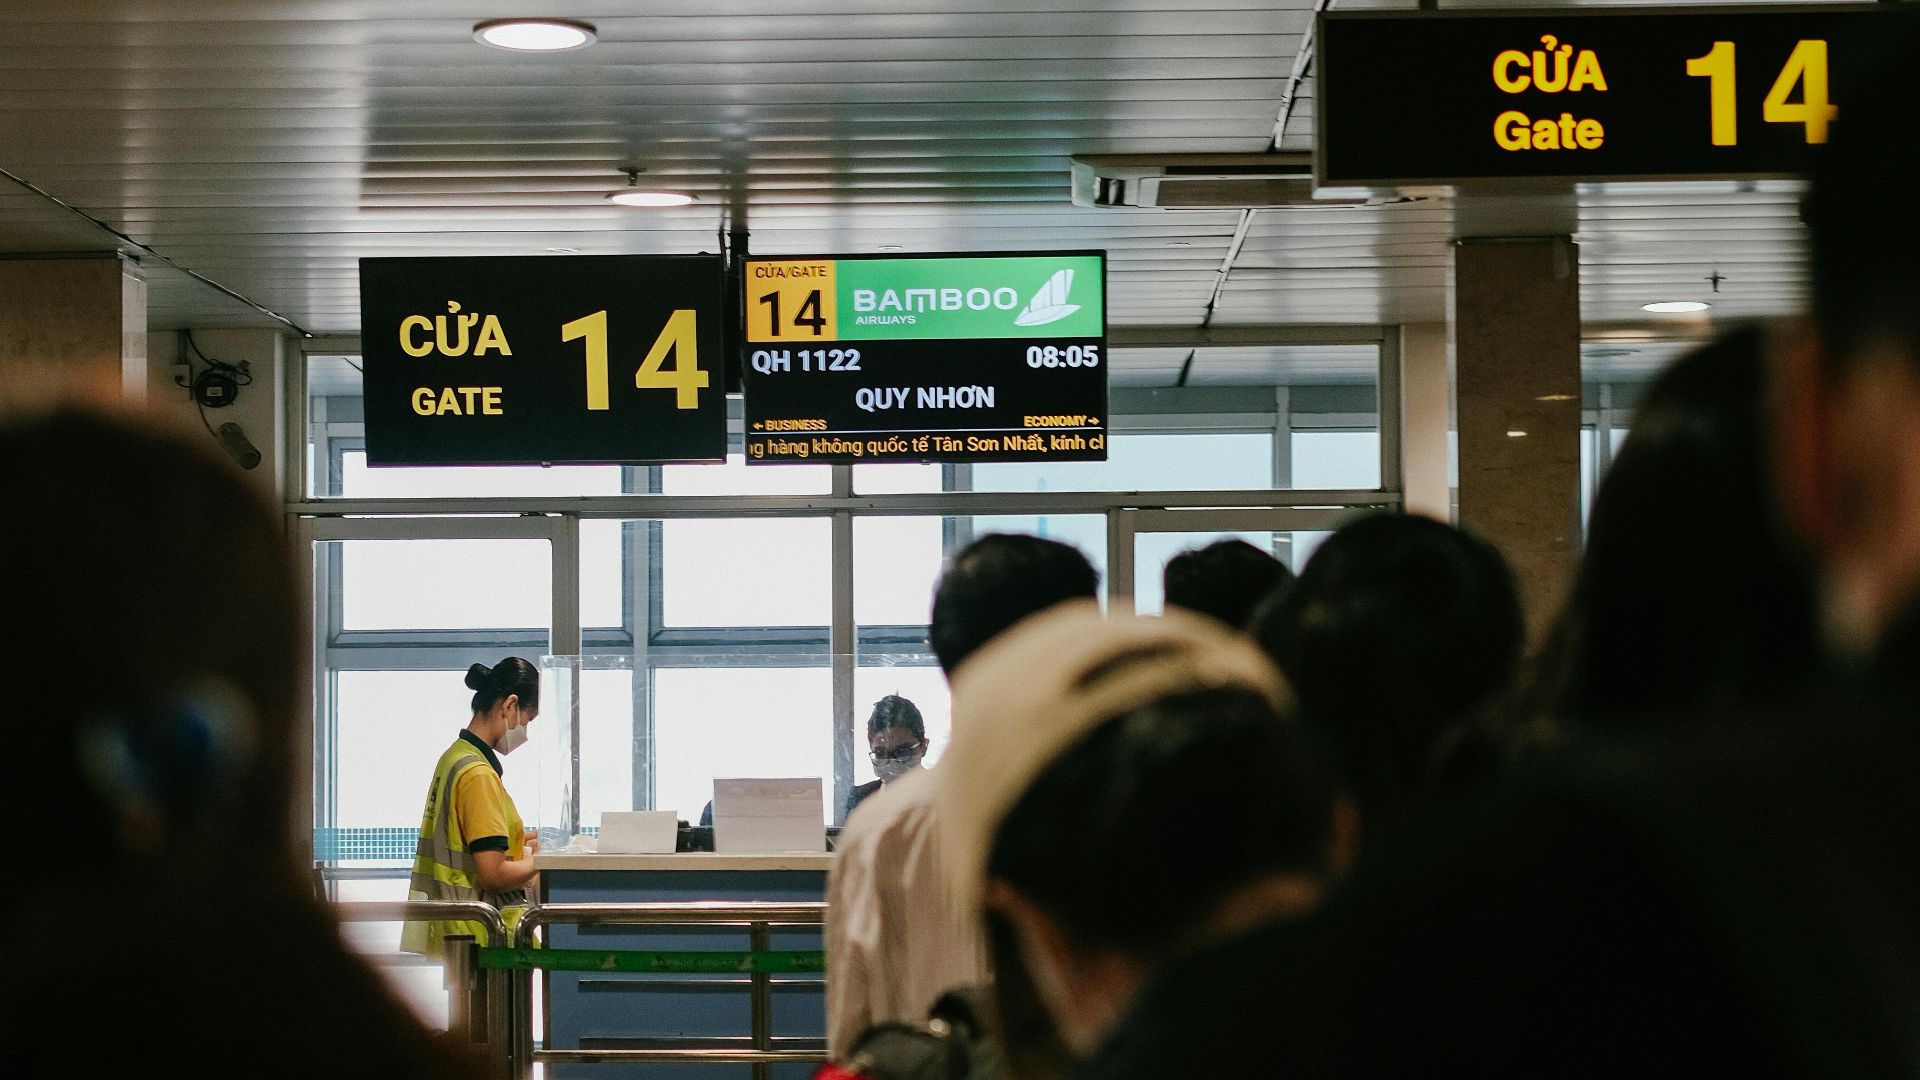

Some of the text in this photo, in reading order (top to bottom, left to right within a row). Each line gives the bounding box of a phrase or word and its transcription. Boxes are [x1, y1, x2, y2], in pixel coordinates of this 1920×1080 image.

[1492, 34, 1608, 94] CỬA
[1685, 39, 1838, 146] 14
[1493, 110, 1605, 151] Gate
[755, 262, 827, 279] CỬA/GATE
[759, 289, 827, 336] 14
[853, 287, 1018, 312] BAMBOO
[399, 301, 512, 357] CỬA
[855, 315, 916, 325] AIRWAYS
[561, 309, 709, 411] 14
[751, 348, 861, 375] QH 1122
[1026, 345, 1099, 369] 08:05
[411, 387, 503, 416] GATE
[855, 385, 995, 413] QUY NHƠN
[765, 419, 828, 431] BUSINESS
[1023, 415, 1087, 428] ECONOMY
[767, 438, 809, 457] hàng
[812, 437, 864, 456] không
[867, 435, 908, 456] quốc
[911, 434, 930, 453] tế
[931, 436, 963, 452] Tân
[967, 436, 1000, 452] Sơn
[1003, 434, 1048, 453] Nhất,
[1050, 434, 1086, 450] kính
